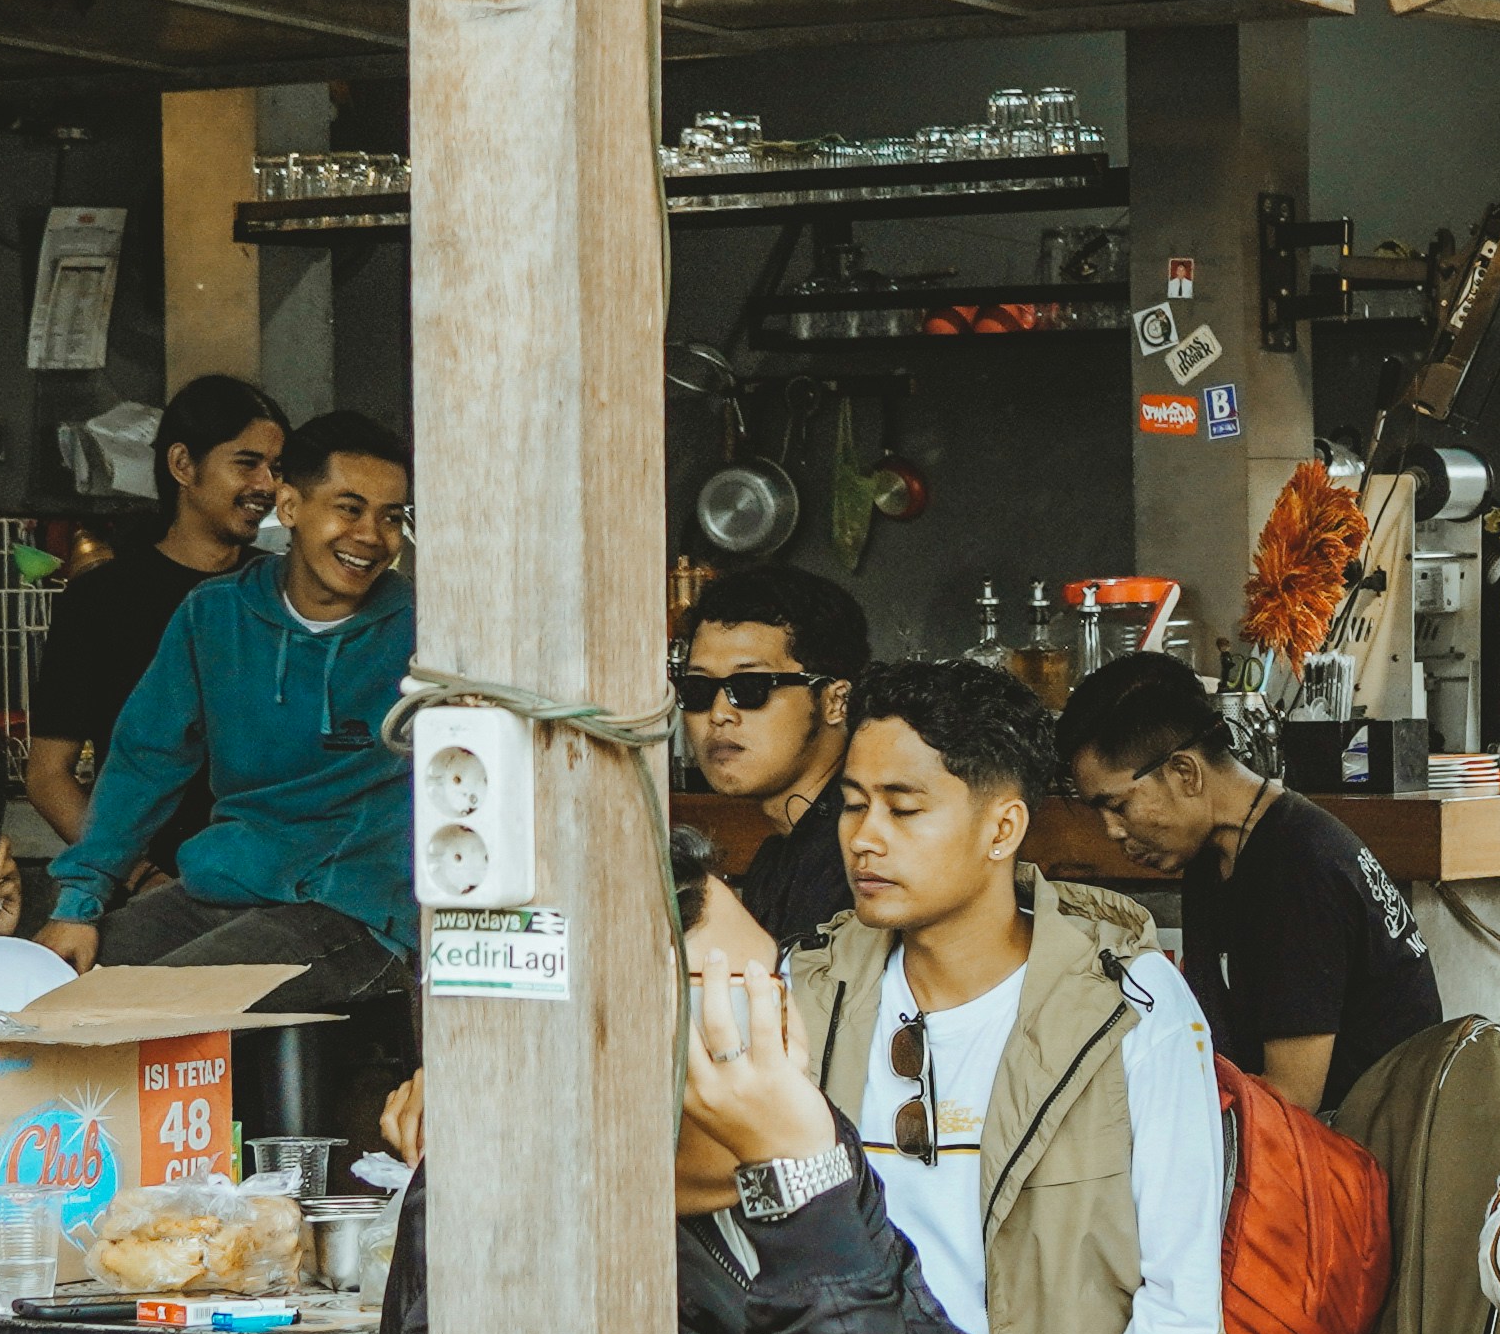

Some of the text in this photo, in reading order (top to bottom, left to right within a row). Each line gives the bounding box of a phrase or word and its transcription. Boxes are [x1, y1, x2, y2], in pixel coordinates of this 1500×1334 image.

[1211, 389, 1231, 419] B
[143, 1057, 226, 1091] ISI TETAP
[159, 1098, 212, 1153] 48
[5, 1119, 103, 1191] Club
